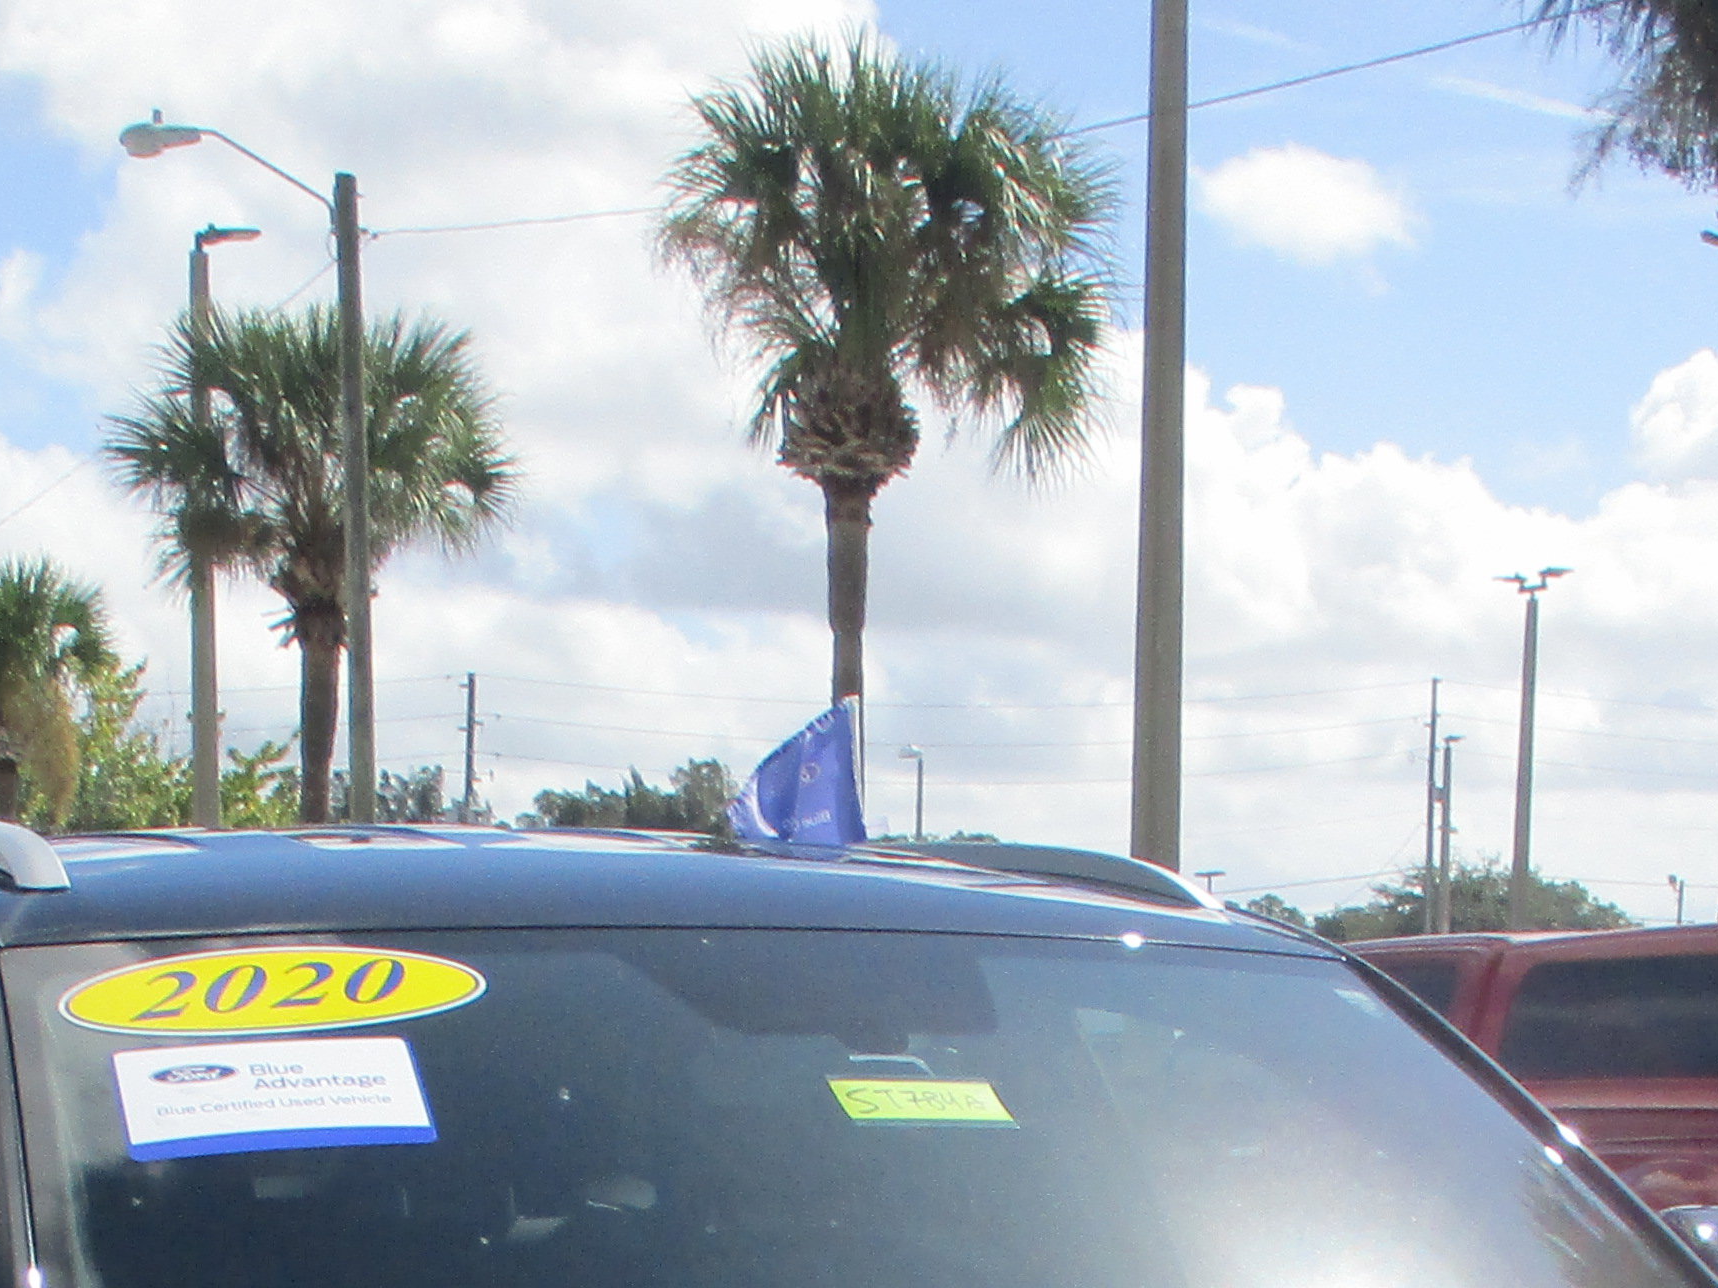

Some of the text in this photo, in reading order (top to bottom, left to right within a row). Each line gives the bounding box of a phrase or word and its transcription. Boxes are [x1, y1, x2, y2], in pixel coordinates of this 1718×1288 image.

[130, 958, 405, 1022] 2020
[249, 1062, 303, 1076] Blue
[254, 1073, 387, 1091] Advantage
[156, 1092, 392, 1117] Blue Certified Used Vehicle
